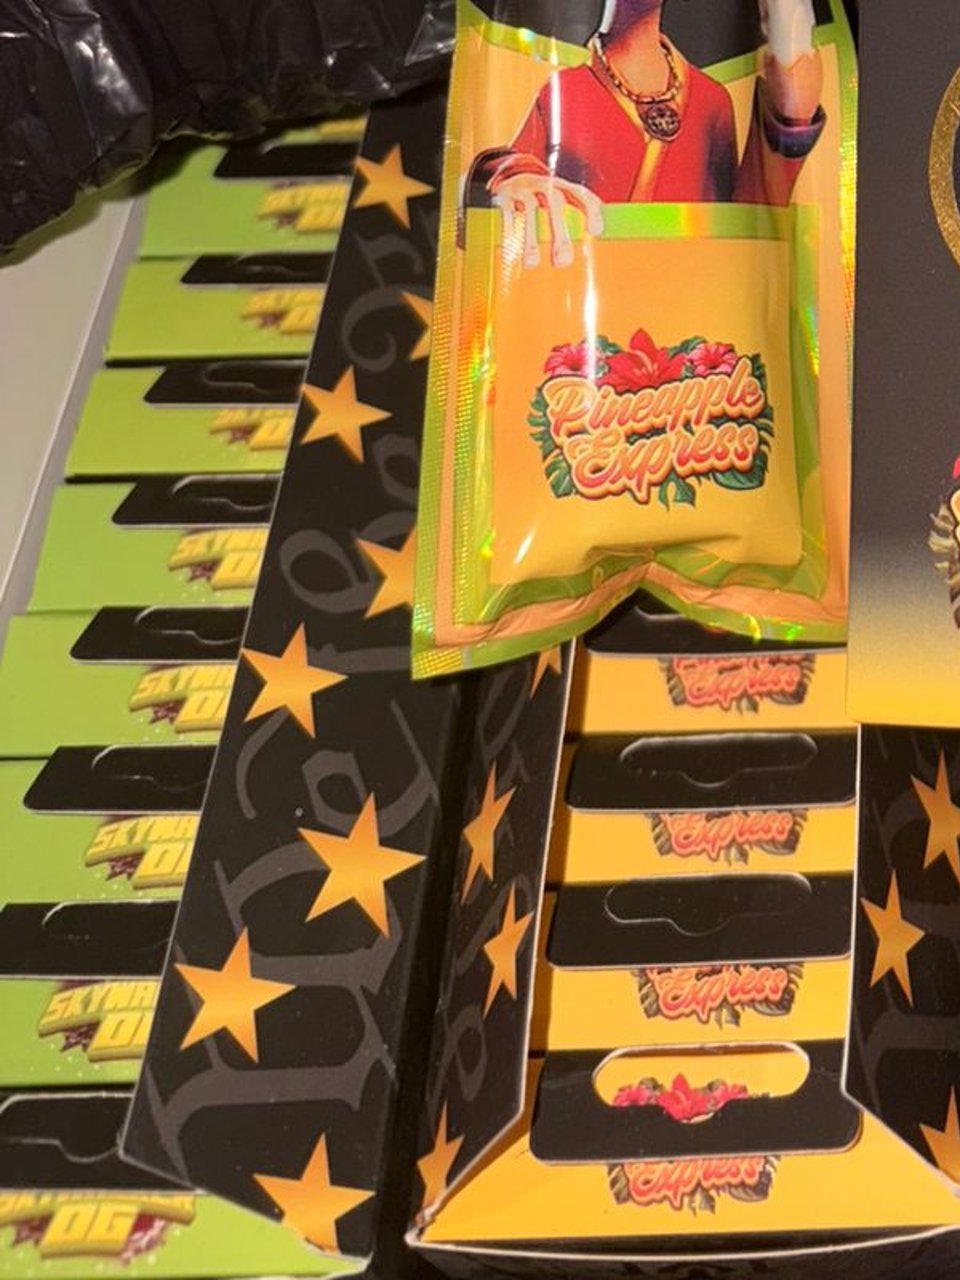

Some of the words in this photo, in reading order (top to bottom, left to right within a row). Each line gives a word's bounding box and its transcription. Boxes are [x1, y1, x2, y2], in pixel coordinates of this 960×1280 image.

[541, 356, 766, 445] Pineapple
[562, 422, 759, 506] Express
[682, 665, 800, 712] Express
[664, 813, 793, 862] Express
[651, 966, 788, 1025] Express
[40, 1203, 142, 1261] OG
